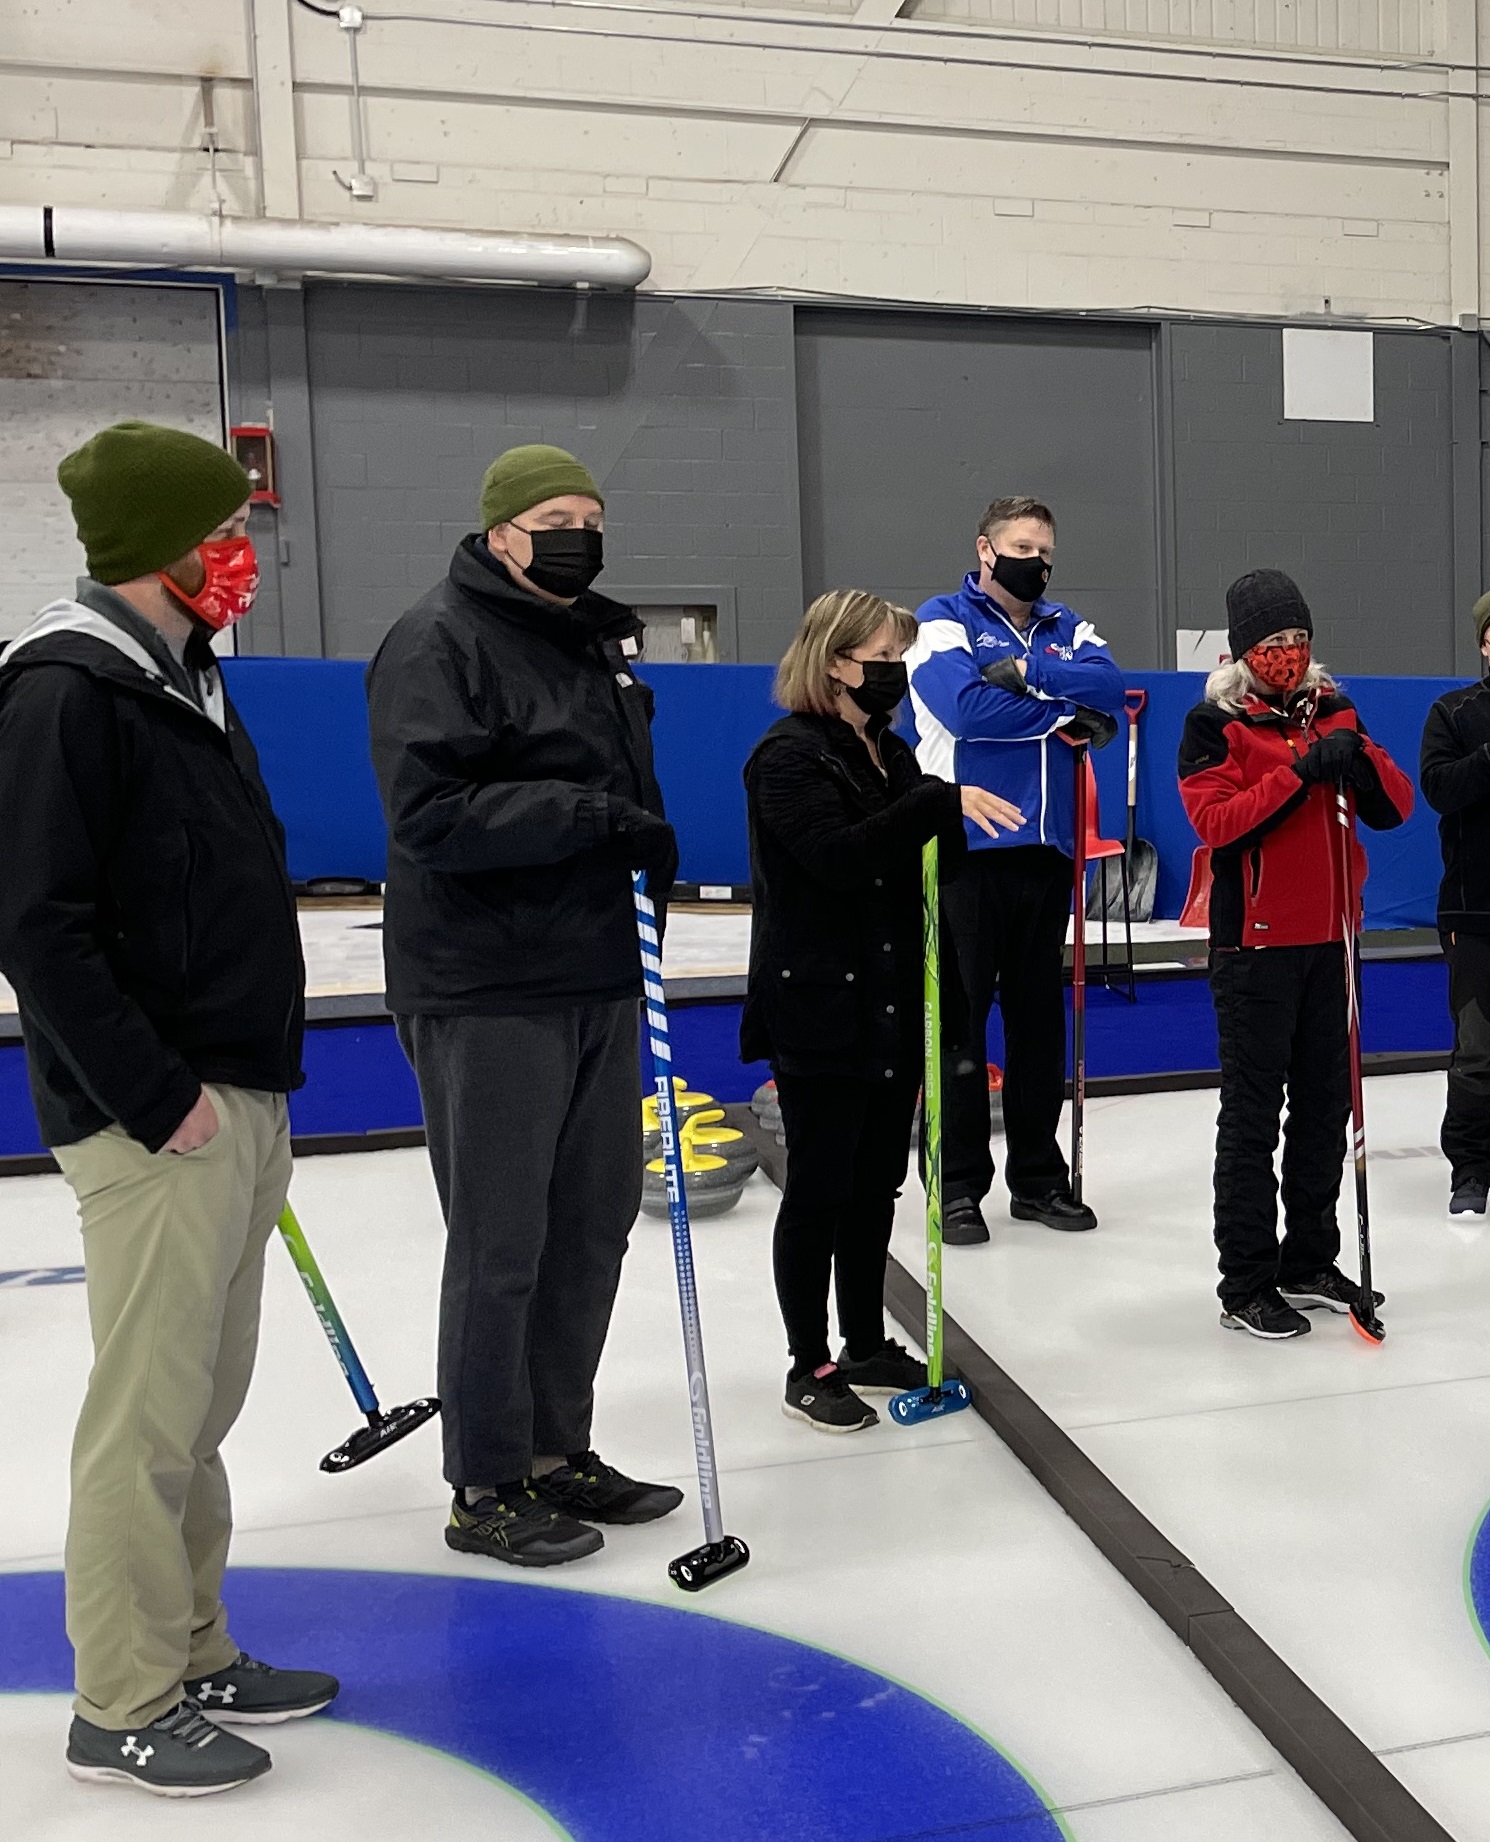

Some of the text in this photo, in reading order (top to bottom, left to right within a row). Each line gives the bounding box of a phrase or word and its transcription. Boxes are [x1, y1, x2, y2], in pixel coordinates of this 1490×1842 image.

[924, 1001, 932, 1057] CARBON
[655, 1076, 679, 1203] FIBERLITE
[379, 1422, 398, 1438] AIR
[692, 1407, 712, 1509] Goldline
